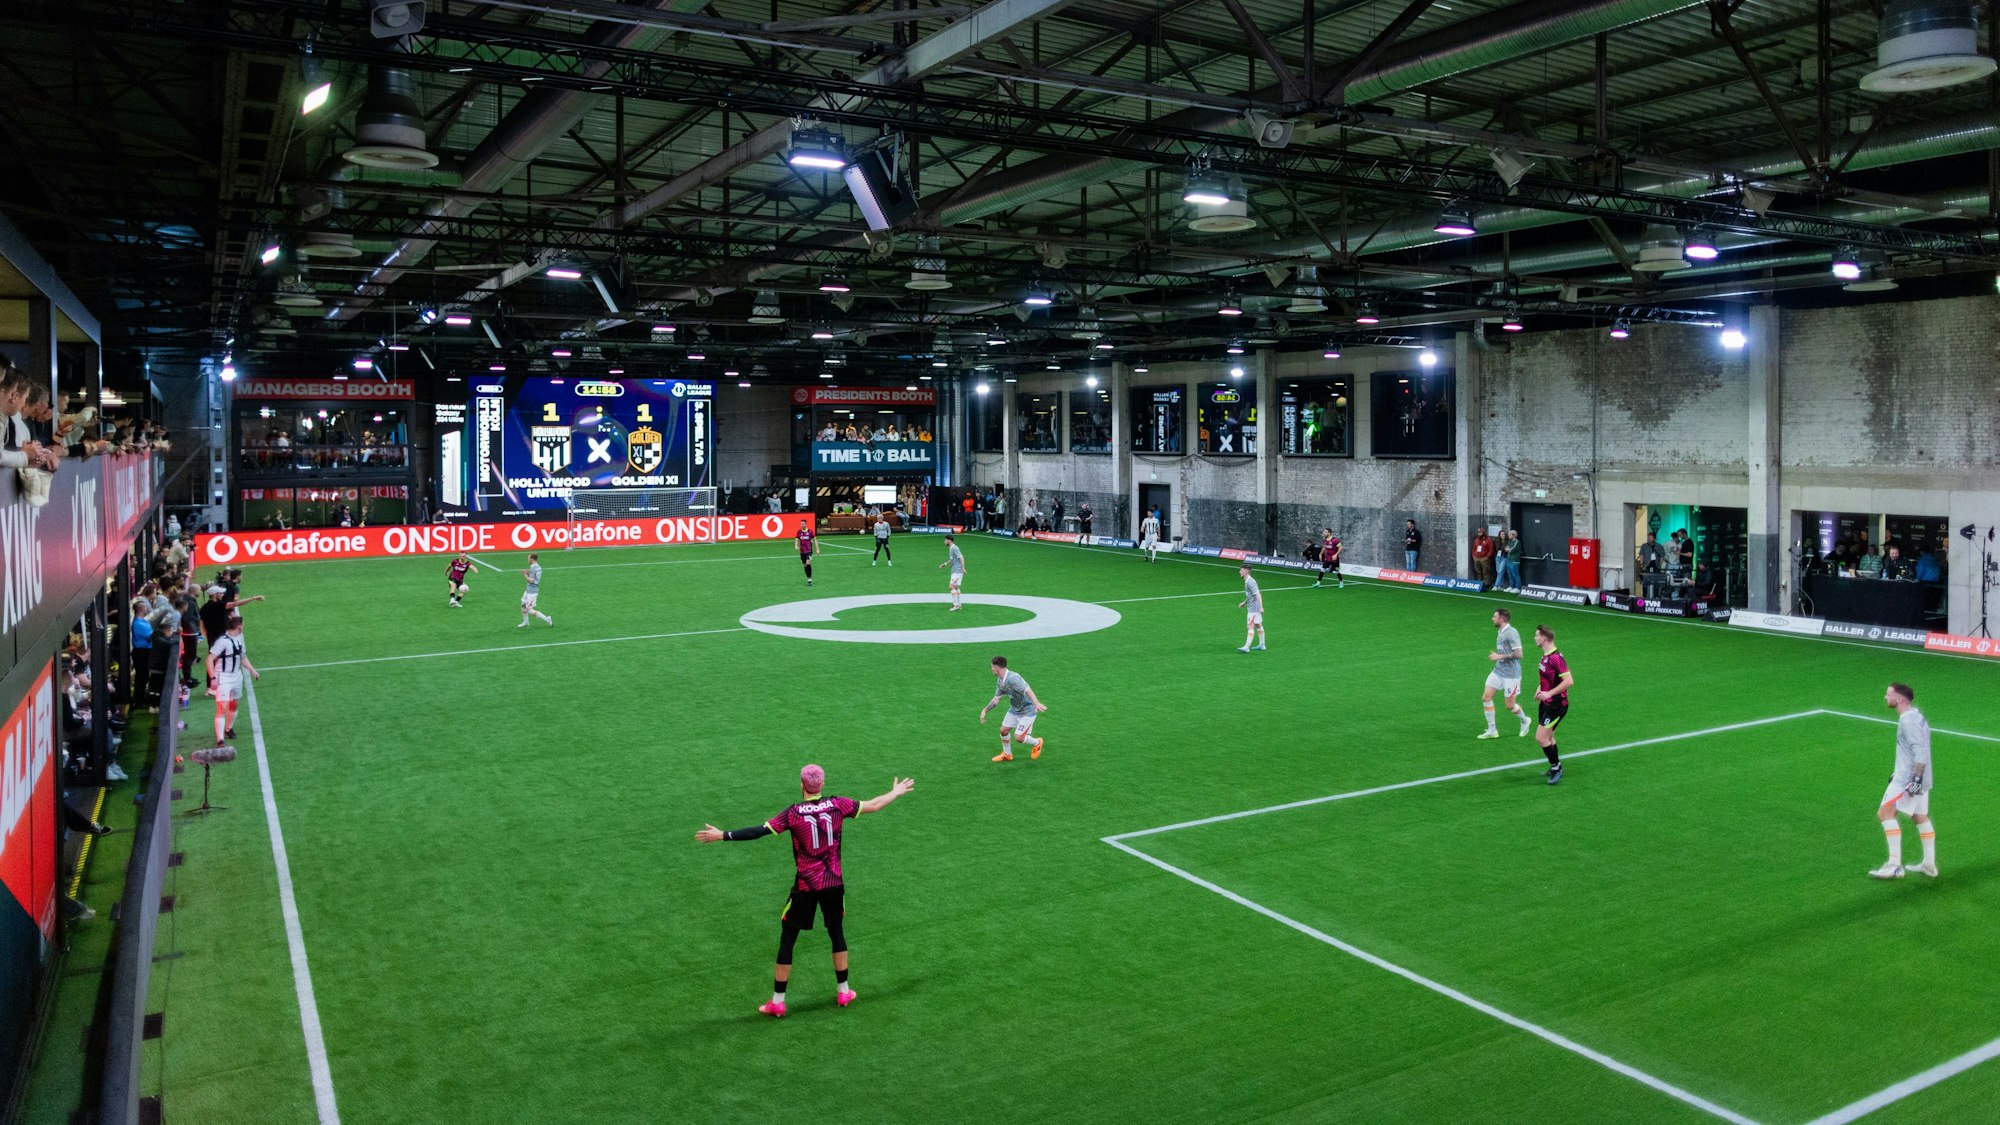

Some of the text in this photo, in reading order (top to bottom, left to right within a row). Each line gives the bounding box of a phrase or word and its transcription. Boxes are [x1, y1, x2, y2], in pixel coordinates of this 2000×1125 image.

[236, 383, 411, 396] MANAGERS BOOTH
[815, 390, 933, 401] PRESIDENTS BOOTH
[543, 403, 560, 421] 1
[637, 404, 653, 422] 1
[480, 399, 490, 483] MOTORWORLD
[818, 449, 860, 463] TIME
[887, 449, 931, 462] BALL
[509, 477, 591, 488] HOLLYWOOD
[611, 475, 679, 486] GOLDEN XI
[80, 478, 97, 561] XING
[541, 516, 749, 544] vodafone ONSIDE
[243, 525, 496, 556] vodafone ONSIDE
[1, 502, 43, 635] XING
[1268, 558, 1285, 566] LEAGUE
[1380, 571, 1399, 579] BALLER
[1424, 578, 1481, 590] BALLER LEAGUE
[1520, 589, 1585, 603] BALLER LEAGUE
[1644, 600, 1661, 608] TVN
[1696, 602, 1708, 610] TVN
[1655, 607, 1683, 615] PRODUCTION
[1825, 625, 1926, 642] BALLER LEAGUE
[1928, 638, 1971, 649] BALLER
[0, 675, 53, 858] ALLER
[803, 812, 834, 849] 11
